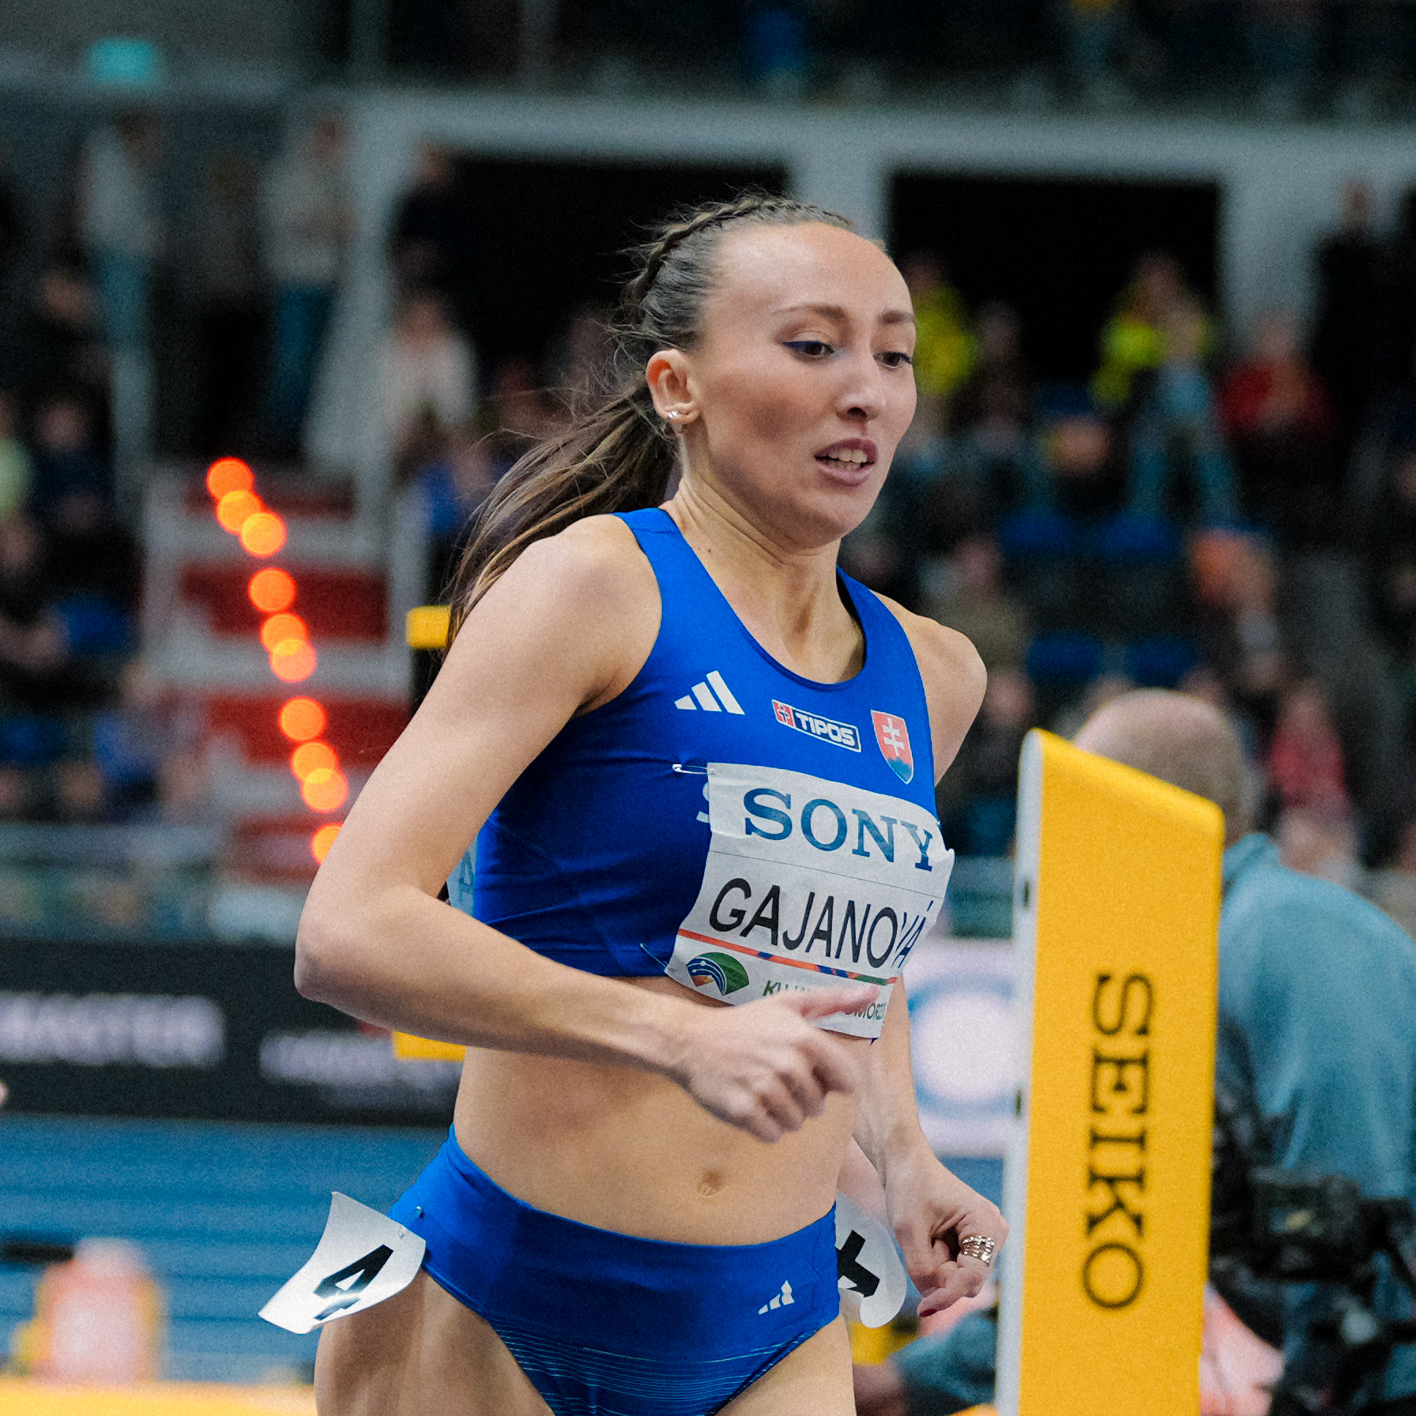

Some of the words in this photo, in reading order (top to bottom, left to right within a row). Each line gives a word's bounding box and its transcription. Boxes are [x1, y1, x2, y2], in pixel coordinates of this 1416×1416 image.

[794, 710, 856, 747] TIPOS
[743, 787, 933, 872] SONY
[1083, 971, 1154, 1310] SEIKO
